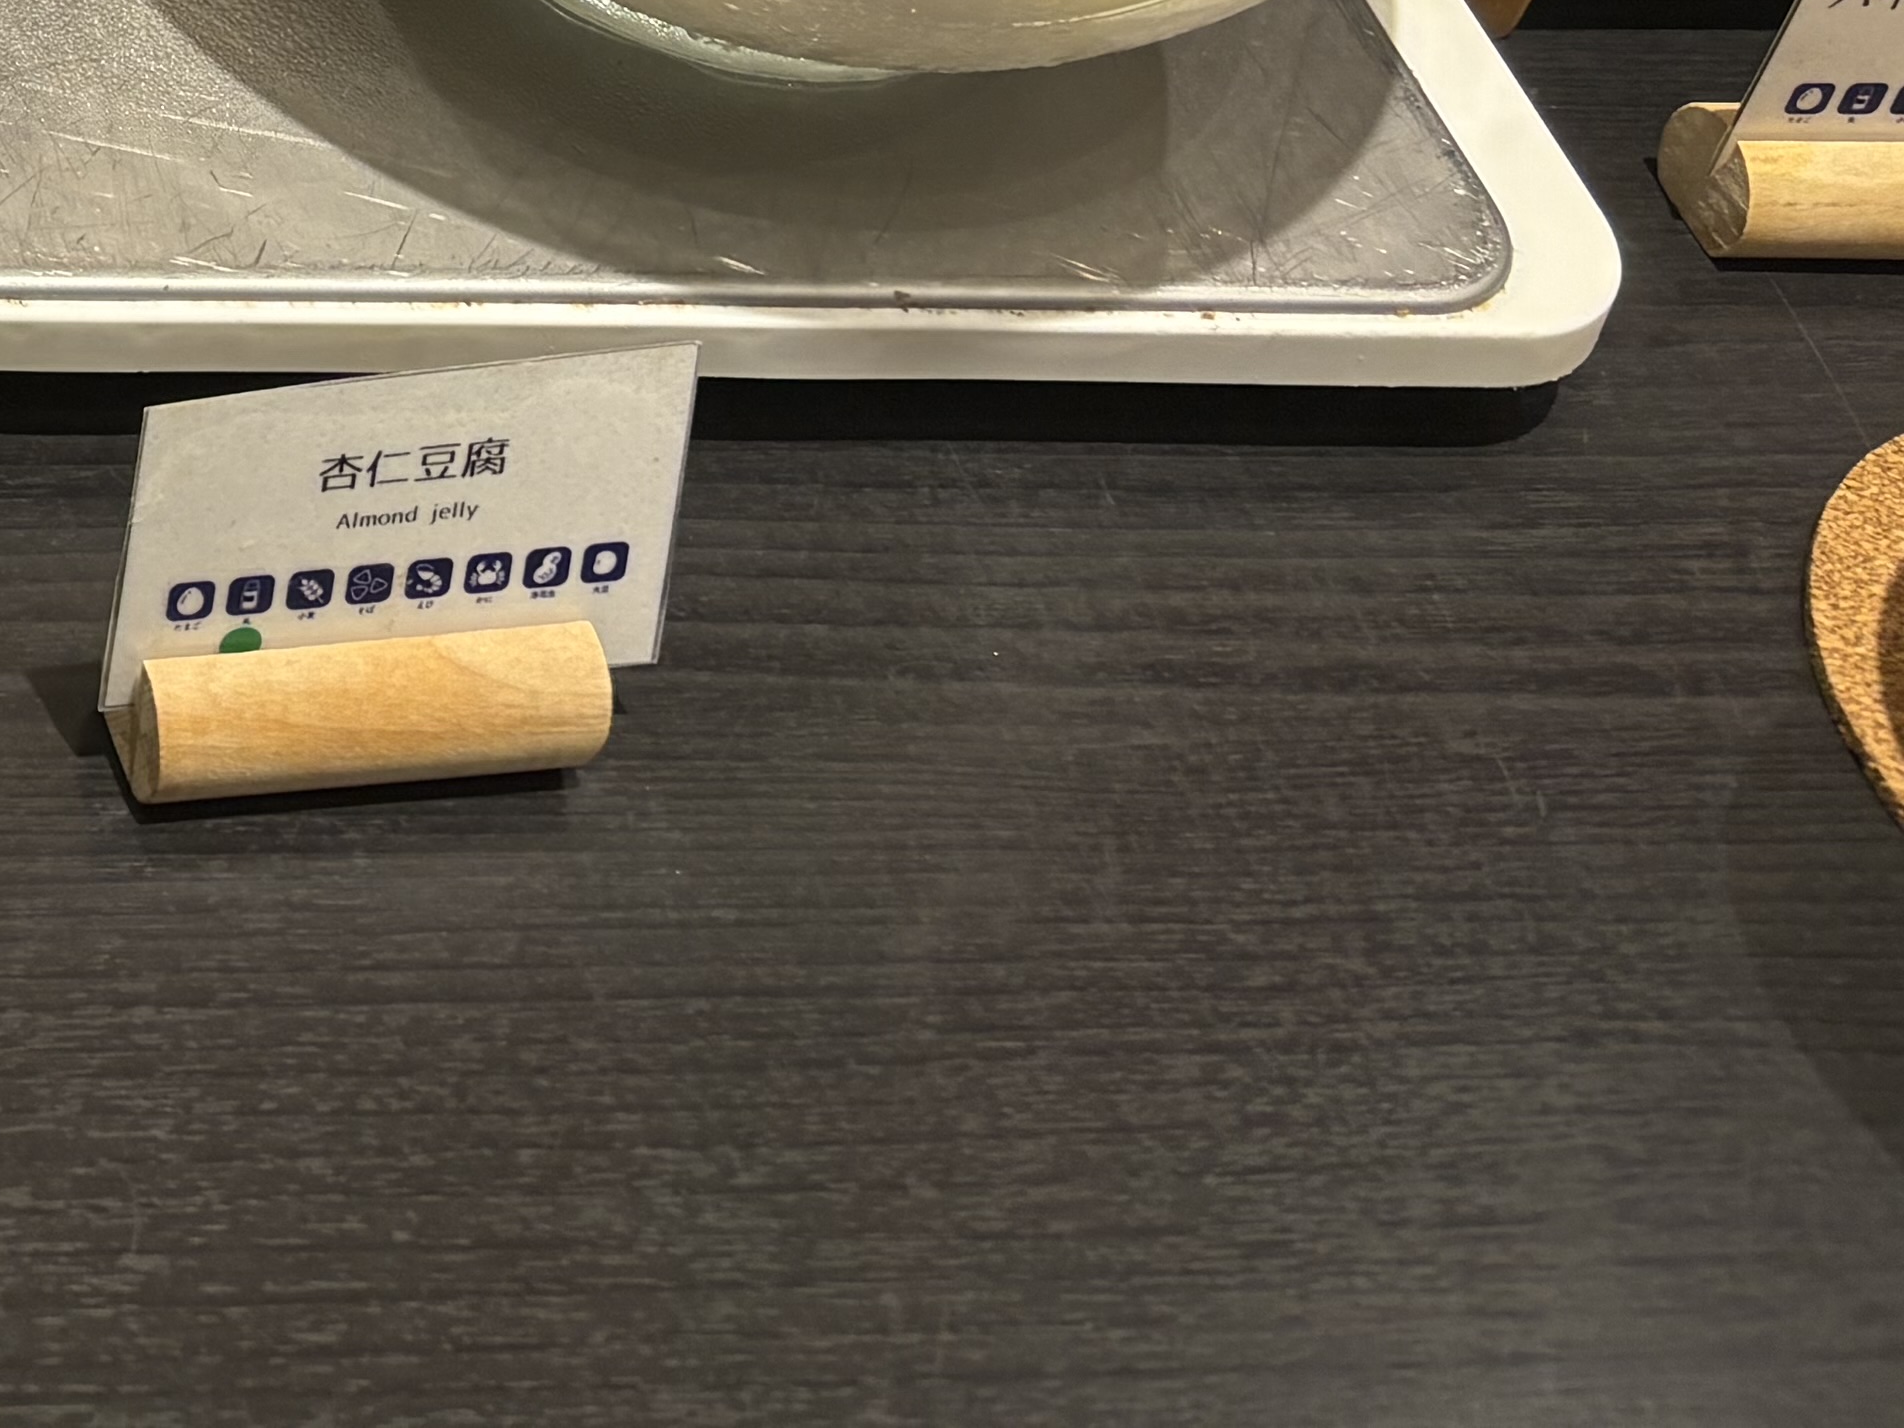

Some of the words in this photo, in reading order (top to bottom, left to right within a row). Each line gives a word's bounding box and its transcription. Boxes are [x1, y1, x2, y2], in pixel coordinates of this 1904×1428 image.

[318, 437, 510, 493] 杏仁豆腐
[335, 505, 419, 531] Almond
[430, 500, 480, 526] jelly
